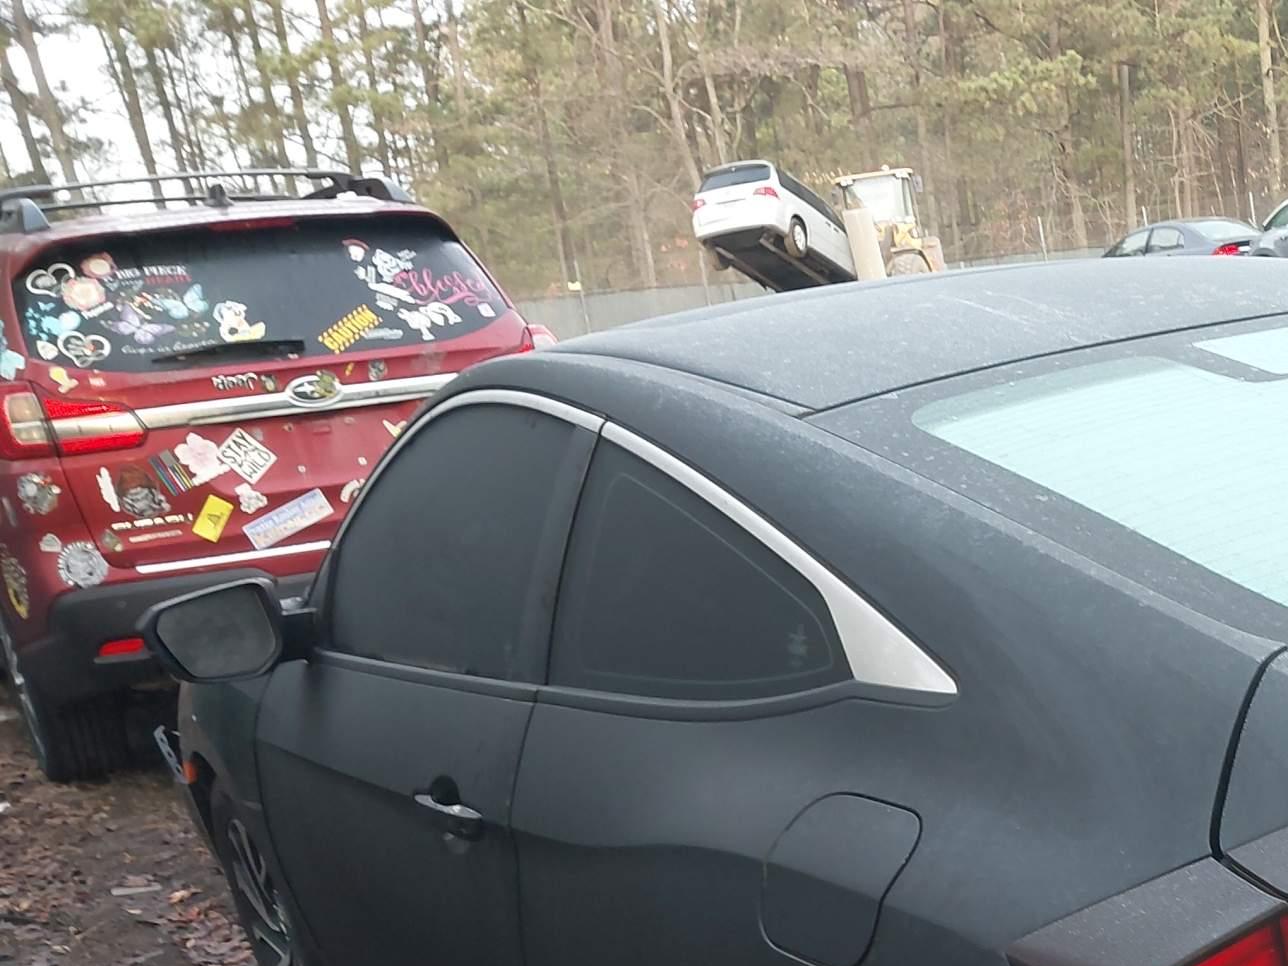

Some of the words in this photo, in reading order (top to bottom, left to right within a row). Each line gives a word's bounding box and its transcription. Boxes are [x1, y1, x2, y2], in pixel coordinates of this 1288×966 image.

[322, 306, 381, 352] CAUTION
[222, 431, 252, 465] STAY
[241, 450, 273, 479] WILD
